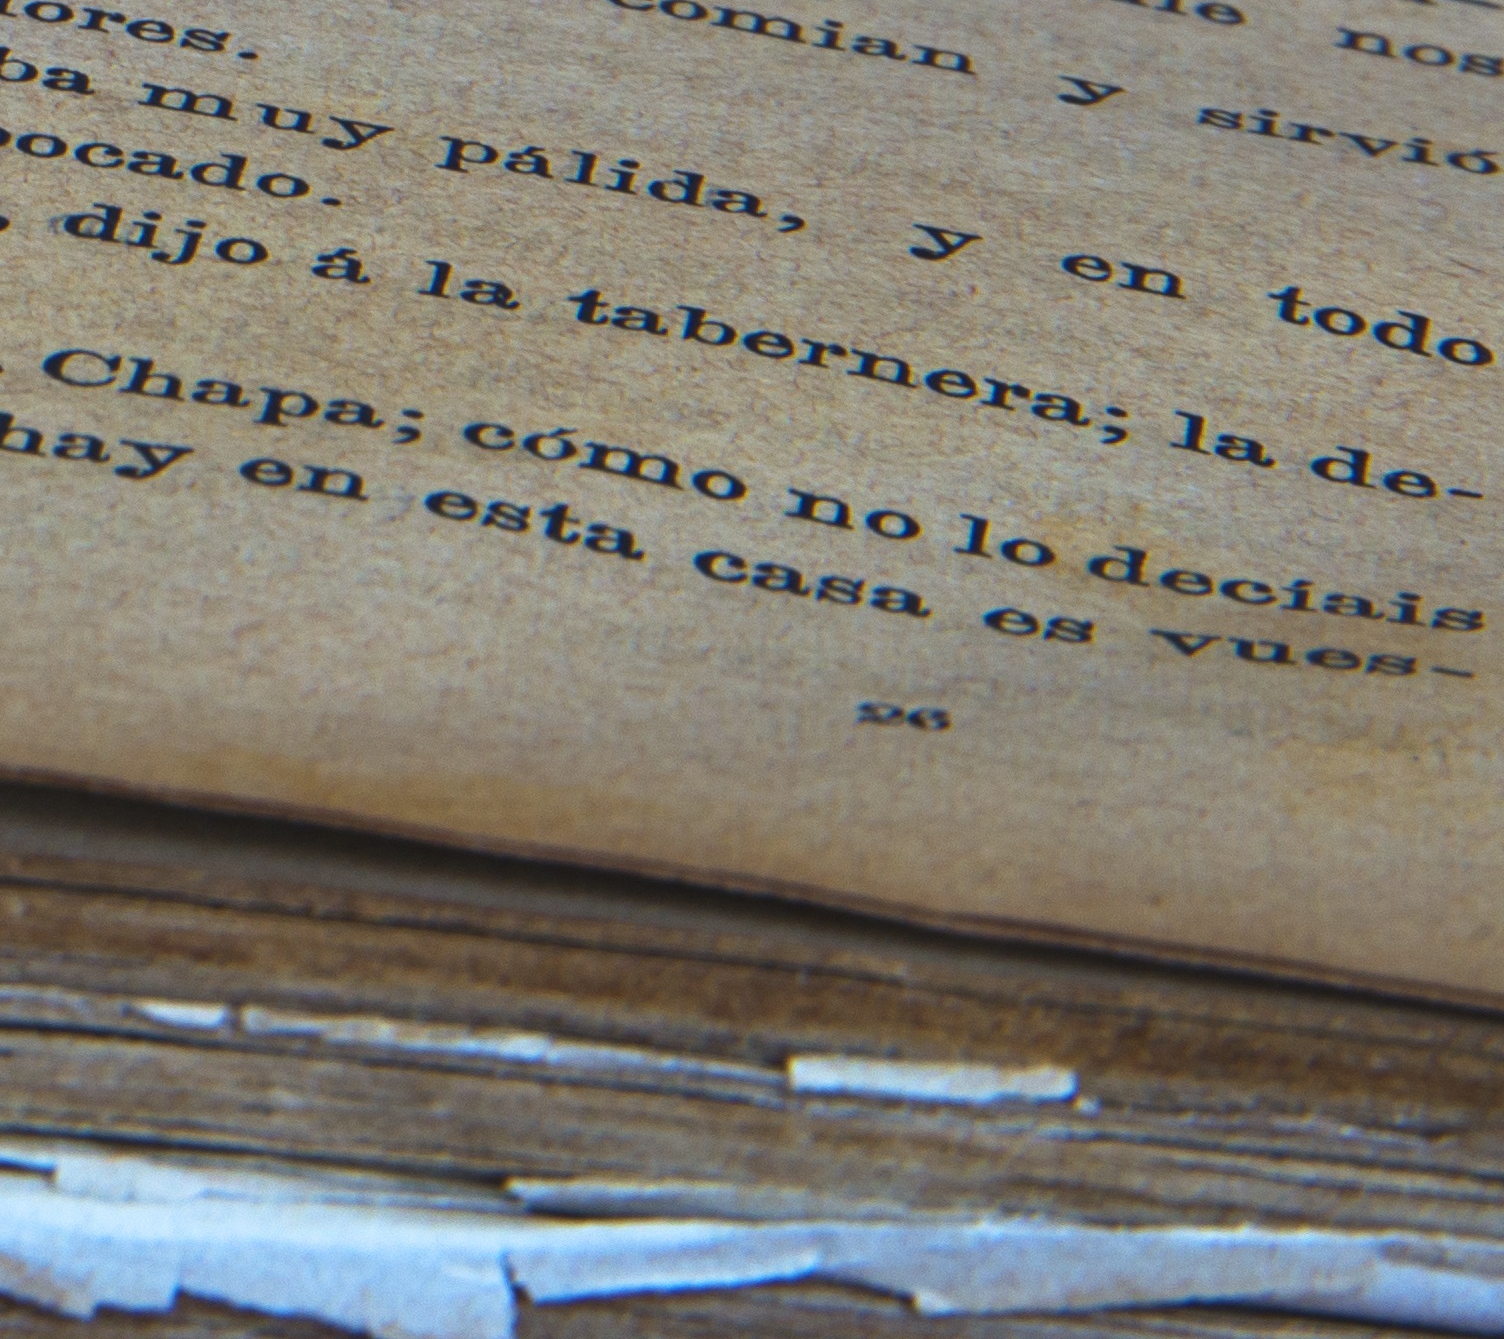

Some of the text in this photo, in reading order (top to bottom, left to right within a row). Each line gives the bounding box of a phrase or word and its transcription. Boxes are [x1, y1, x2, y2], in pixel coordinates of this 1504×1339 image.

[1058, 76, 1123, 107] y
[1197, 107, 1499, 175] sirvió
[1335, 27, 1504, 78] nos
[137, 82, 392, 151] muy
[437, 136, 805, 233] pálida,
[909, 223, 980, 261] y
[1061, 254, 1184, 299] en
[1268, 286, 1492, 367] todo
[63, 203, 268, 265] dijo
[311, 247, 370, 285] á
[418, 260, 520, 310] la
[568, 289, 1127, 445] tabernera;
[1170, 410, 1274, 468] la
[1309, 445, 1482, 499] de-
[41, 349, 423, 444] Chapa;
[462, 422, 746, 501] cómo
[785, 488, 920, 540] no
[954, 514, 1055, 567] lo
[1086, 546, 1483, 631] decíais
[239, 458, 367, 502] en
[424, 490, 644, 561] esta
[692, 550, 930, 618] casa
[982, 607, 1093, 643] es
[1150, 628, 1473, 678] vues-
